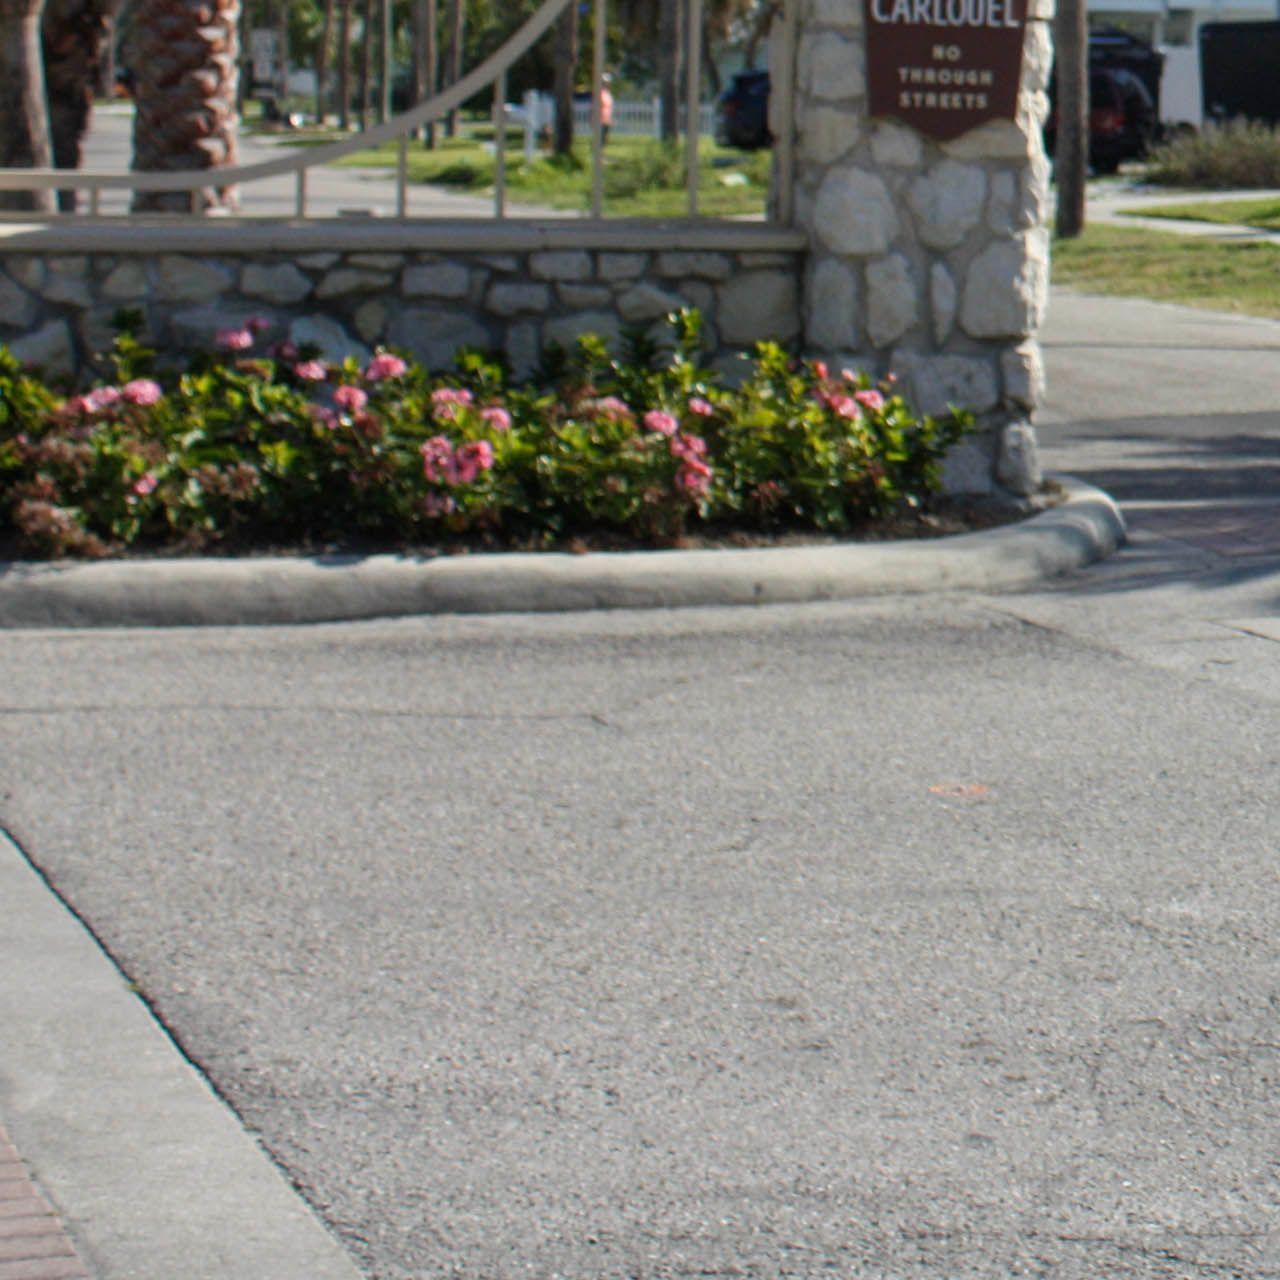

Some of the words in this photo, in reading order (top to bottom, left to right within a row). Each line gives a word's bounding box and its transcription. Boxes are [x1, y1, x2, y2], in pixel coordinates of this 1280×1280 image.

[932, 45, 961, 61] NO
[899, 68, 993, 85] THROUGH
[900, 93, 987, 108] STREETS
